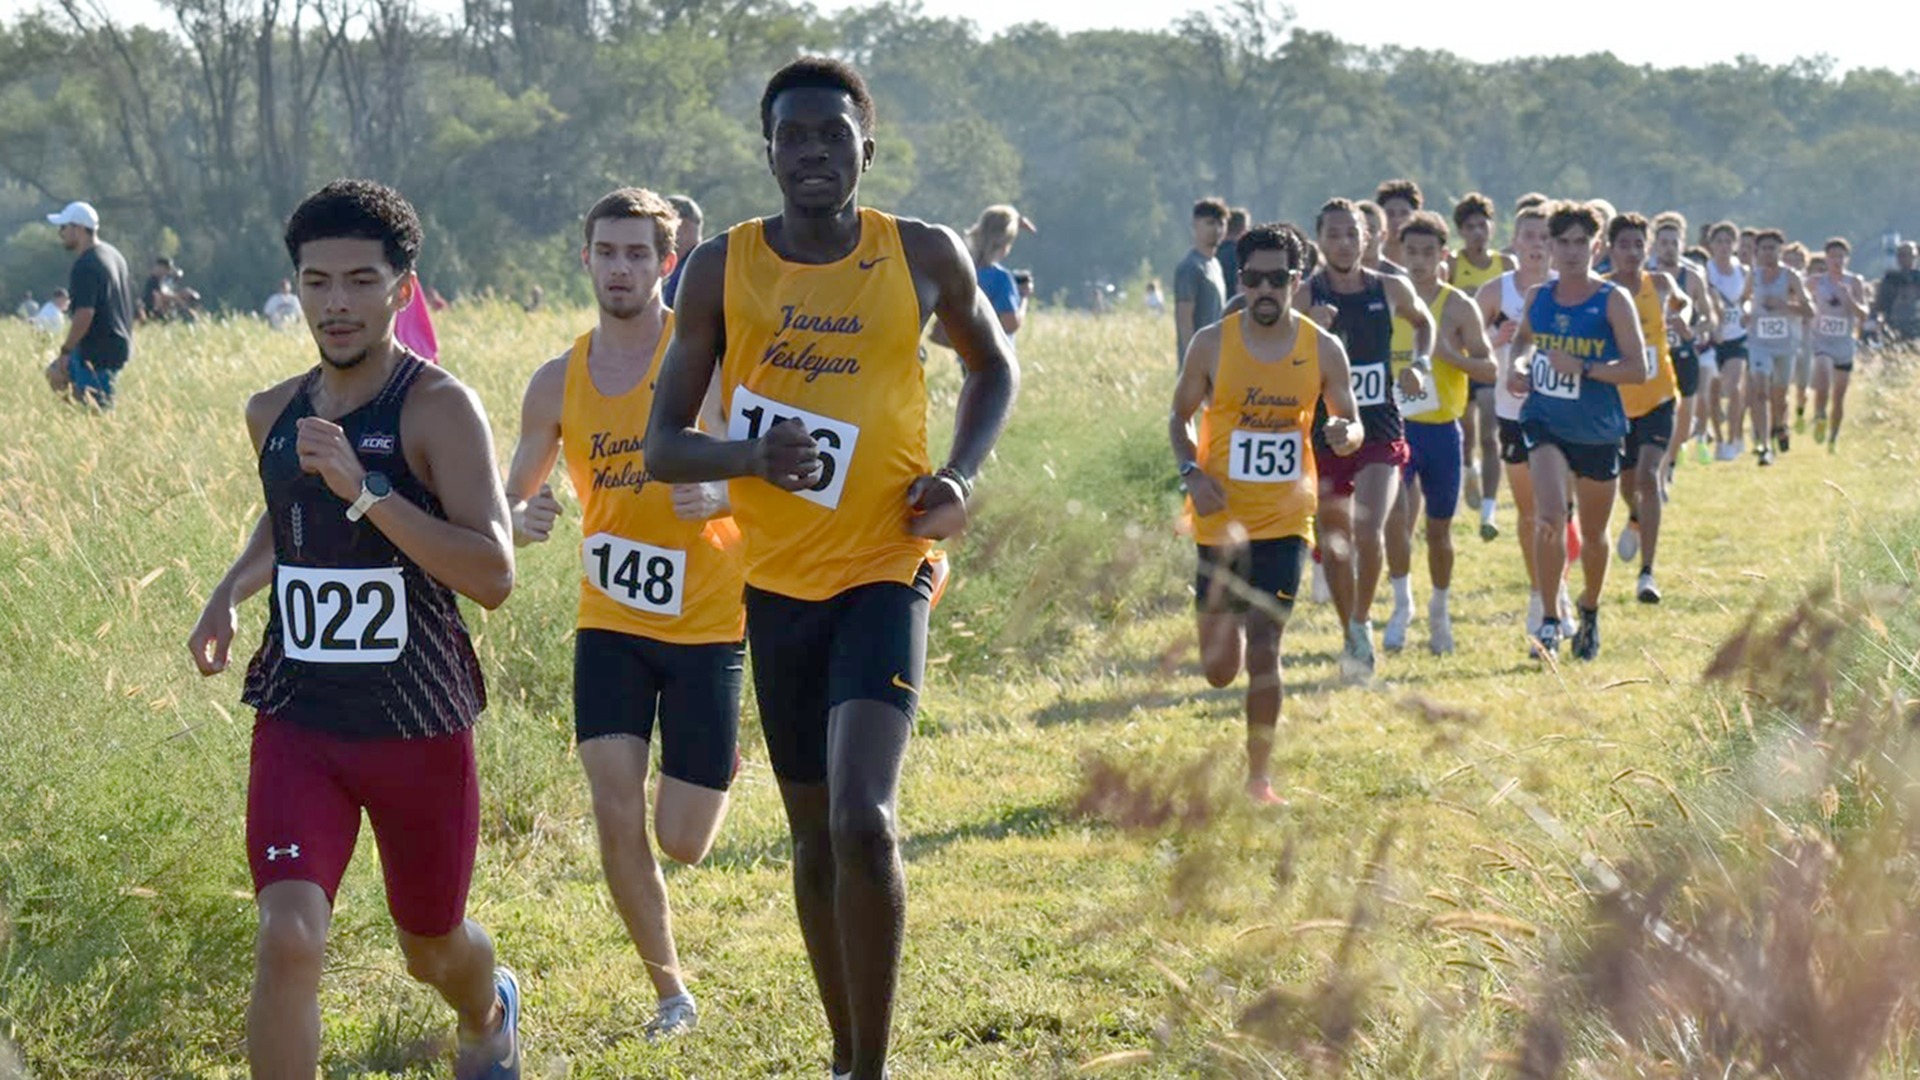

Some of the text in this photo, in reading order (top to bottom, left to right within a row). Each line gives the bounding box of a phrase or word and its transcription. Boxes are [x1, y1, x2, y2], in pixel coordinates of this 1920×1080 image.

[1760, 321, 1784, 336] 182
[1532, 333, 1606, 358] ETHANY
[1350, 370, 1381, 400] 20
[1535, 360, 1576, 393] 004
[1242, 387, 1299, 407] Kansas
[588, 431, 644, 460] Kans
[741, 405, 842, 492] 16
[1237, 438, 1296, 477] 153
[591, 542, 674, 606] 148
[285, 579, 400, 650] 022
